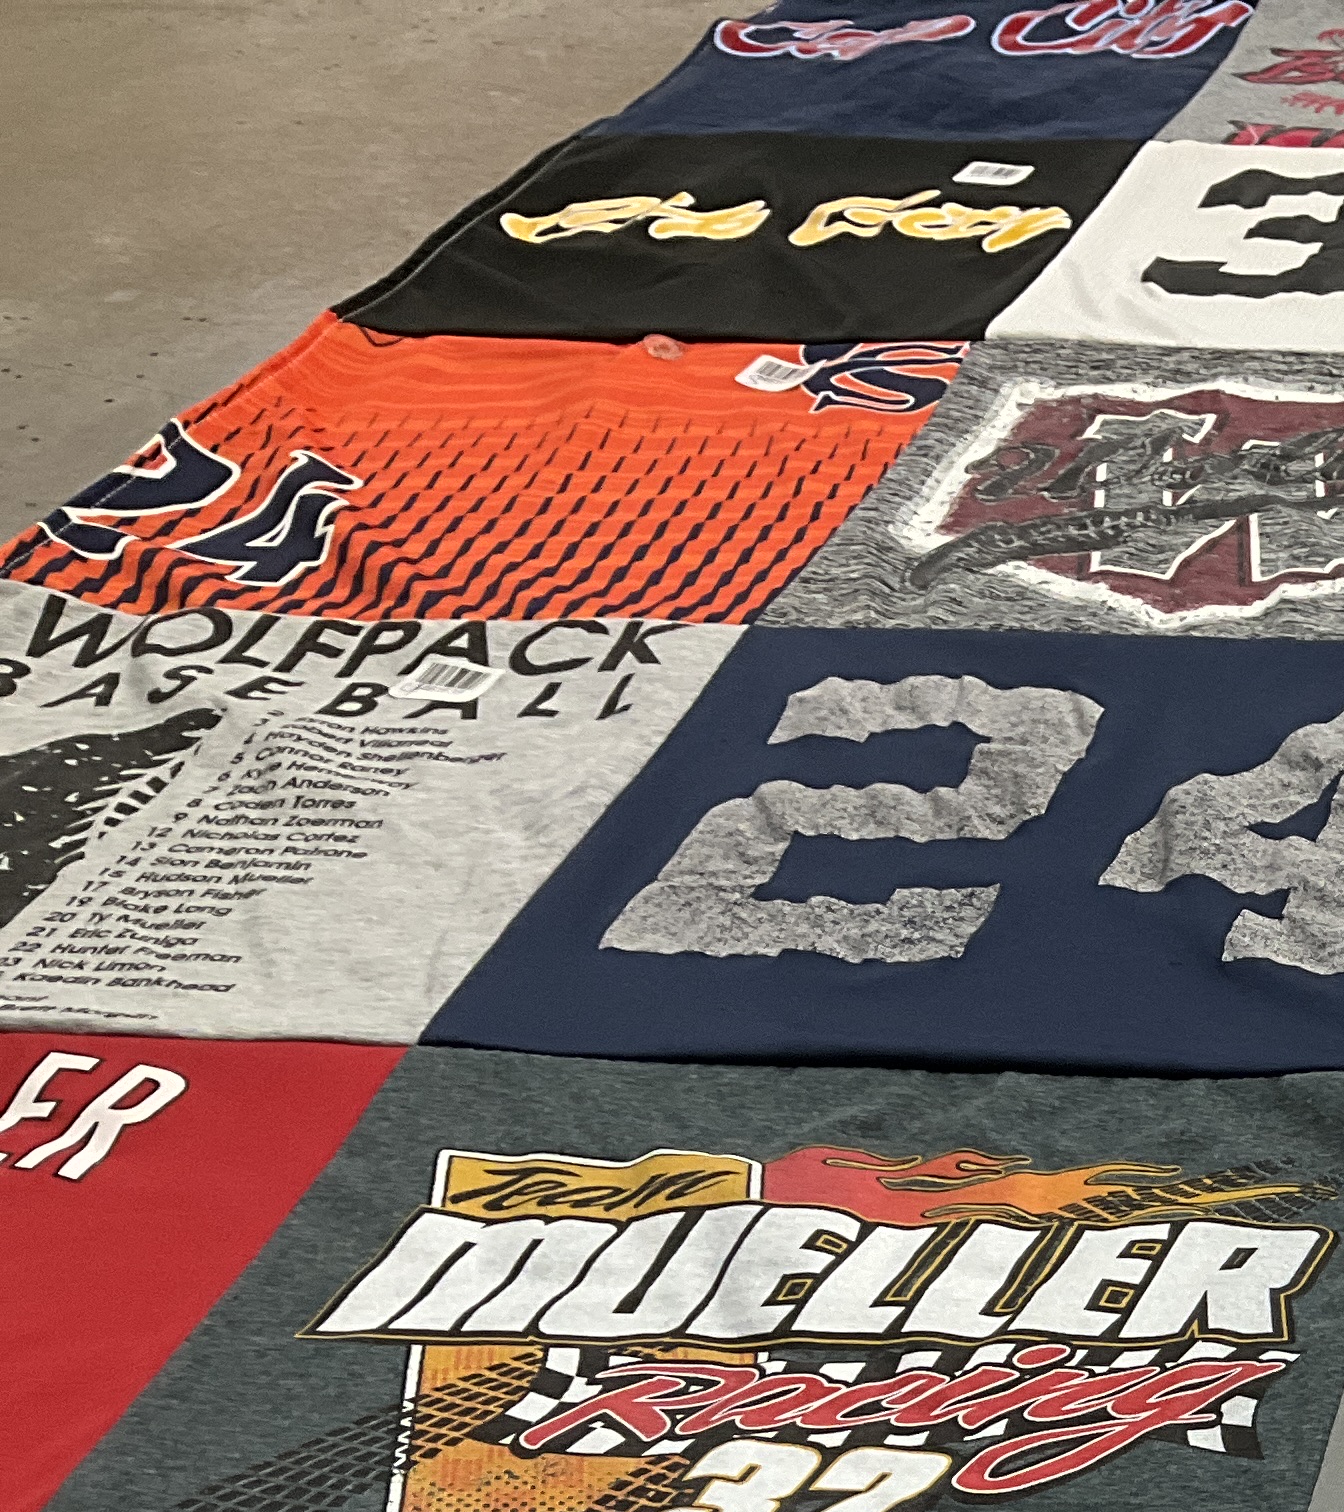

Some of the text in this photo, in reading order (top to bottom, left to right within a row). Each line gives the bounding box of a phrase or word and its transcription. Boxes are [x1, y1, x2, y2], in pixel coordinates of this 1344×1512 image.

[25, 593, 690, 680] WOLFPACK
[280, 775, 392, 798] Anderson
[197, 813, 279, 829] Nathan
[147, 826, 172, 839] 12
[115, 854, 142, 868] 14
[134, 870, 223, 884] Hudson
[227, 870, 315, 886] Mueller
[82, 880, 110, 894] 17
[65, 895, 93, 908] 19
[173, 903, 234, 918] Long
[43, 911, 78, 924] 20
[26, 925, 201, 949] 21 Eric Zuniga
[7, 941, 42, 954] 22
[50, 942, 133, 956] Hunter
[32, 957, 91, 972] Nick
[93, 960, 168, 974] Limon
[105, 975, 238, 994] Bankhead
[300, 1205, 1335, 1343] MUELLER
[525, 1345, 1284, 1493] Racing
